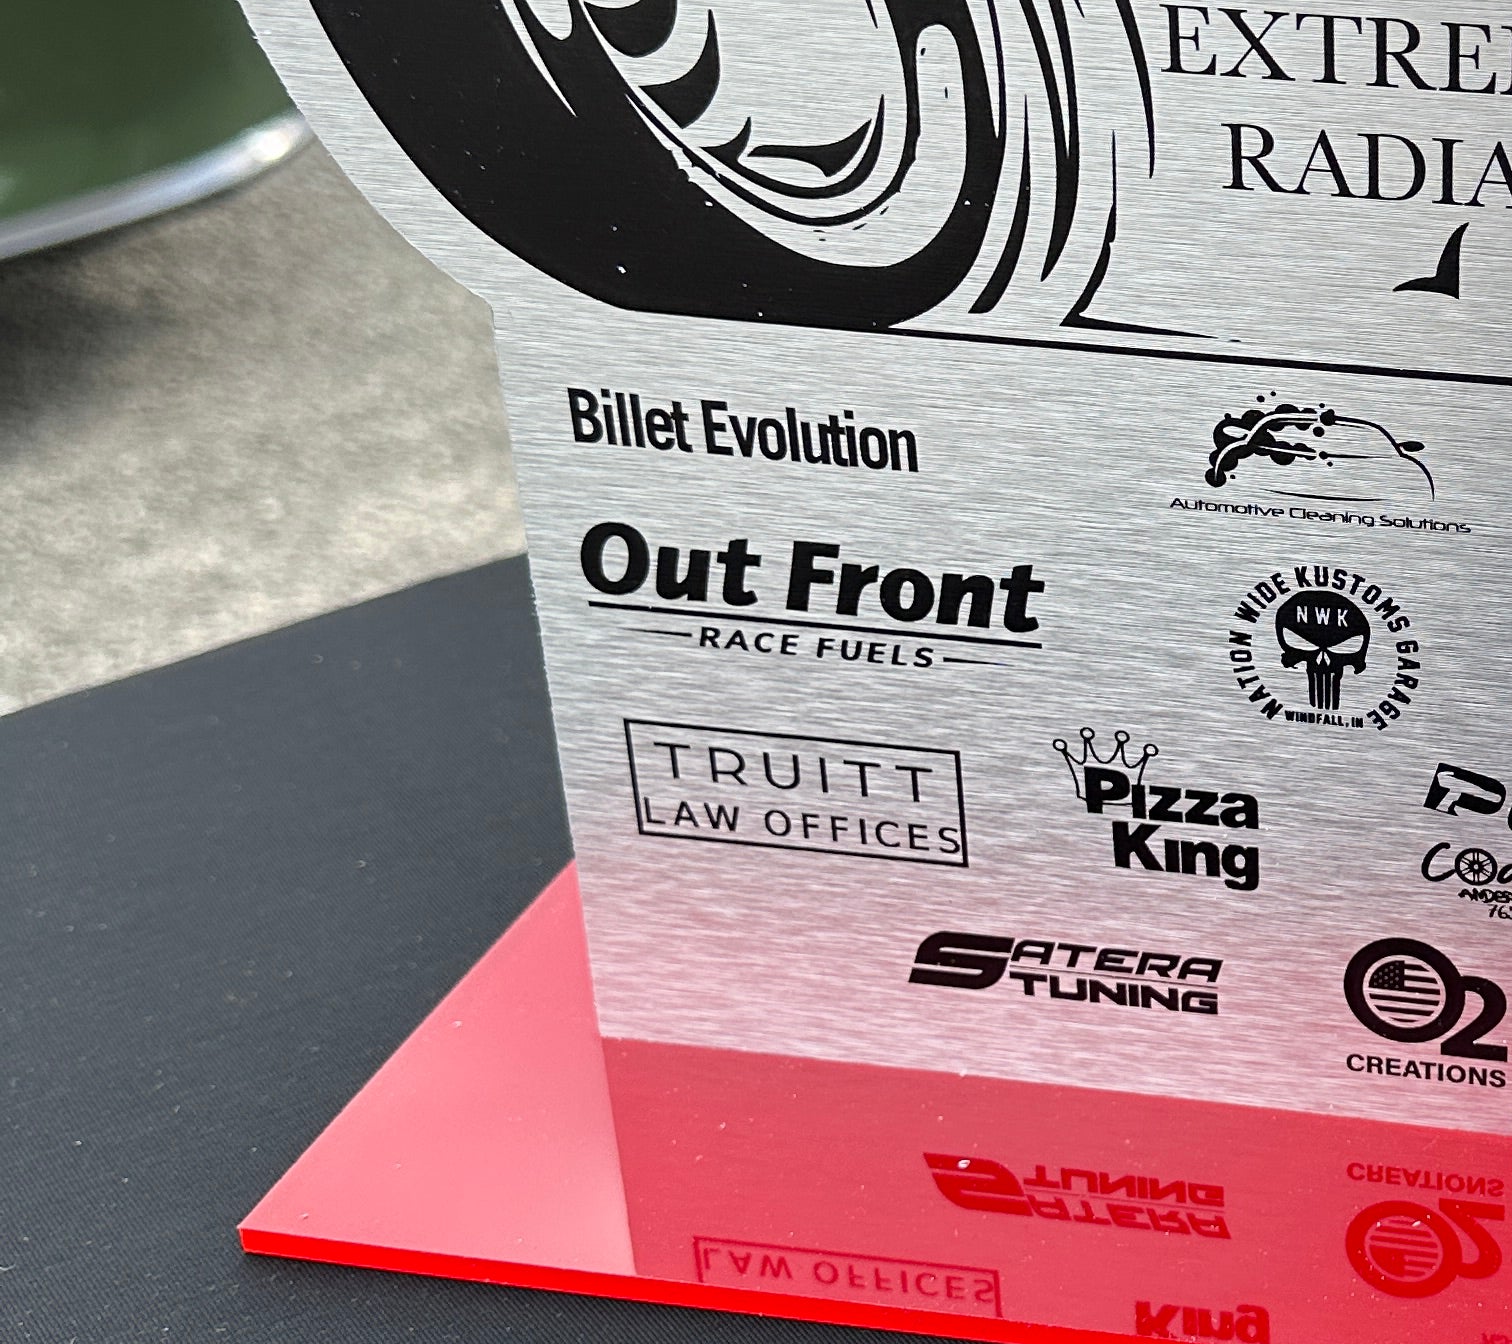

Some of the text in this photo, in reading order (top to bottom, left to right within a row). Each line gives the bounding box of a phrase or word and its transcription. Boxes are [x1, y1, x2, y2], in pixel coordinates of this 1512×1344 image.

[567, 387, 919, 473] Billet Evolution
[1170, 497, 1471, 534] Automotive Cleaning Solutions
[579, 522, 1045, 632] Out Front
[699, 626, 934, 669] RACE FUELS
[1229, 565, 1421, 731] NATION WIDE KUSTOMS GARAGE
[653, 741, 933, 804] TRUITT
[1083, 765, 1260, 830] Pizza
[644, 797, 961, 855] LAW OFFICES
[1111, 820, 1261, 892] King
[907, 931, 1223, 989] SATERA
[1009, 970, 1219, 1015] TUNING
[1346, 1053, 1507, 1088] CREATIONS
